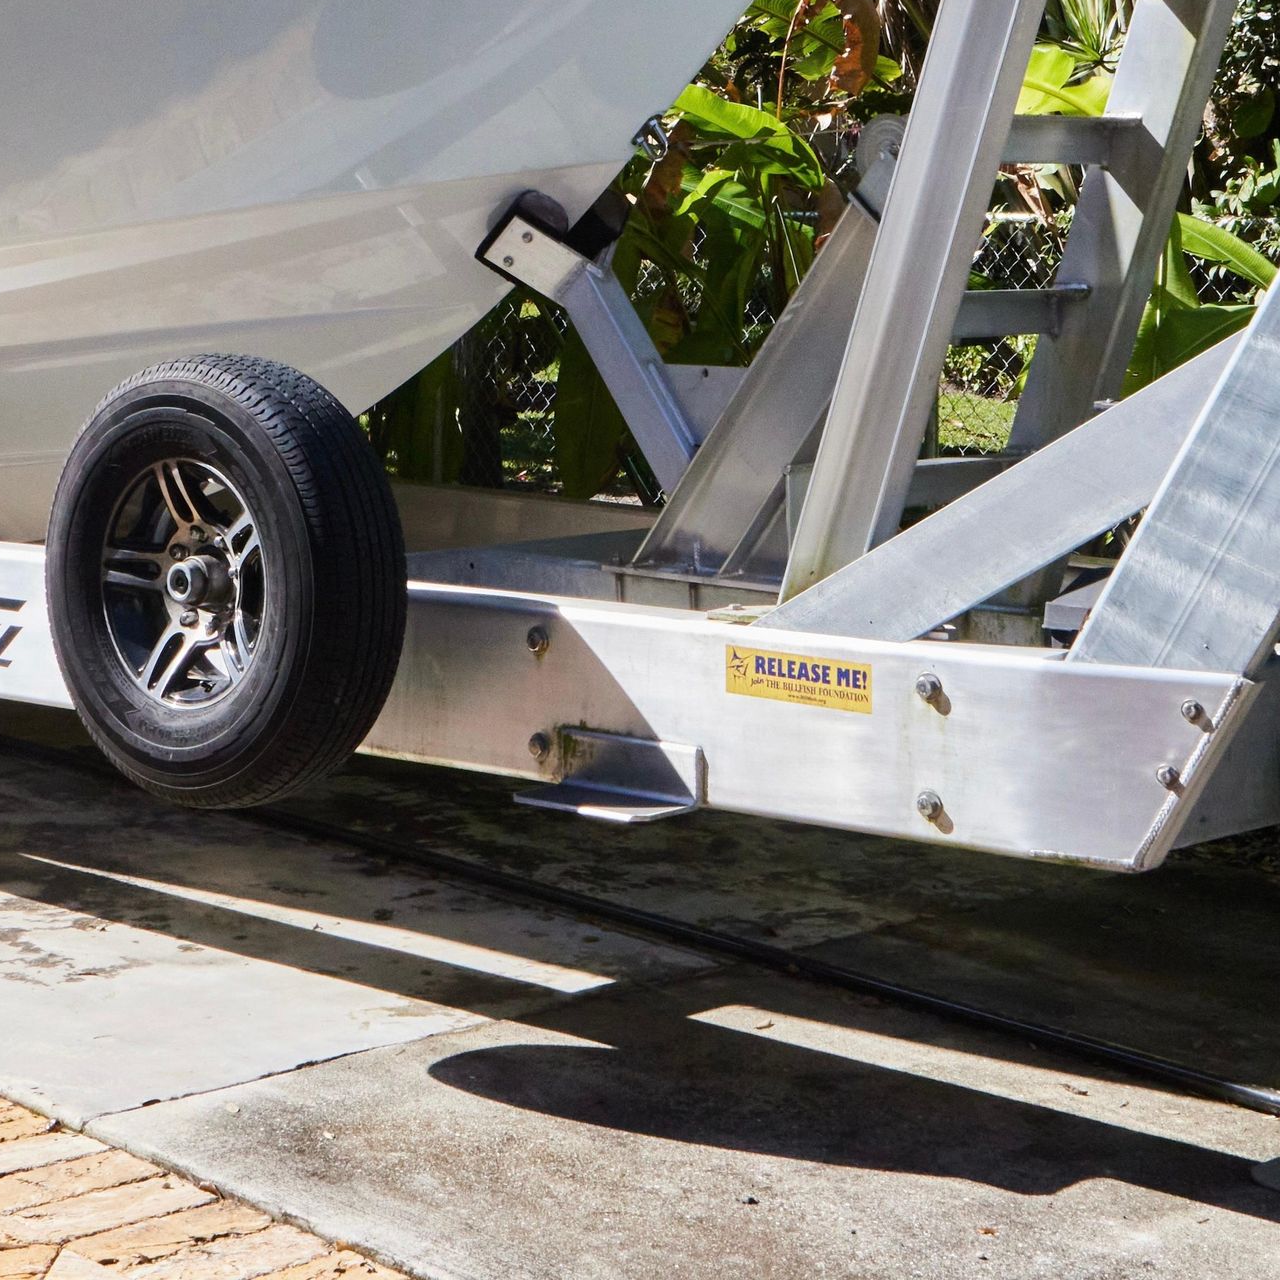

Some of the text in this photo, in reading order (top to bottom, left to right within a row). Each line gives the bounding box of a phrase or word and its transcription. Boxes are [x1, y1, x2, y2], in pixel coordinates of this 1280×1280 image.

[755, 655, 868, 690] RELEASE ME!
[751, 677, 764, 687] Join
[766, 679, 780, 689] THE
[783, 682, 816, 695] BILLFISH
[818, 688, 869, 703] FOUNDATION
